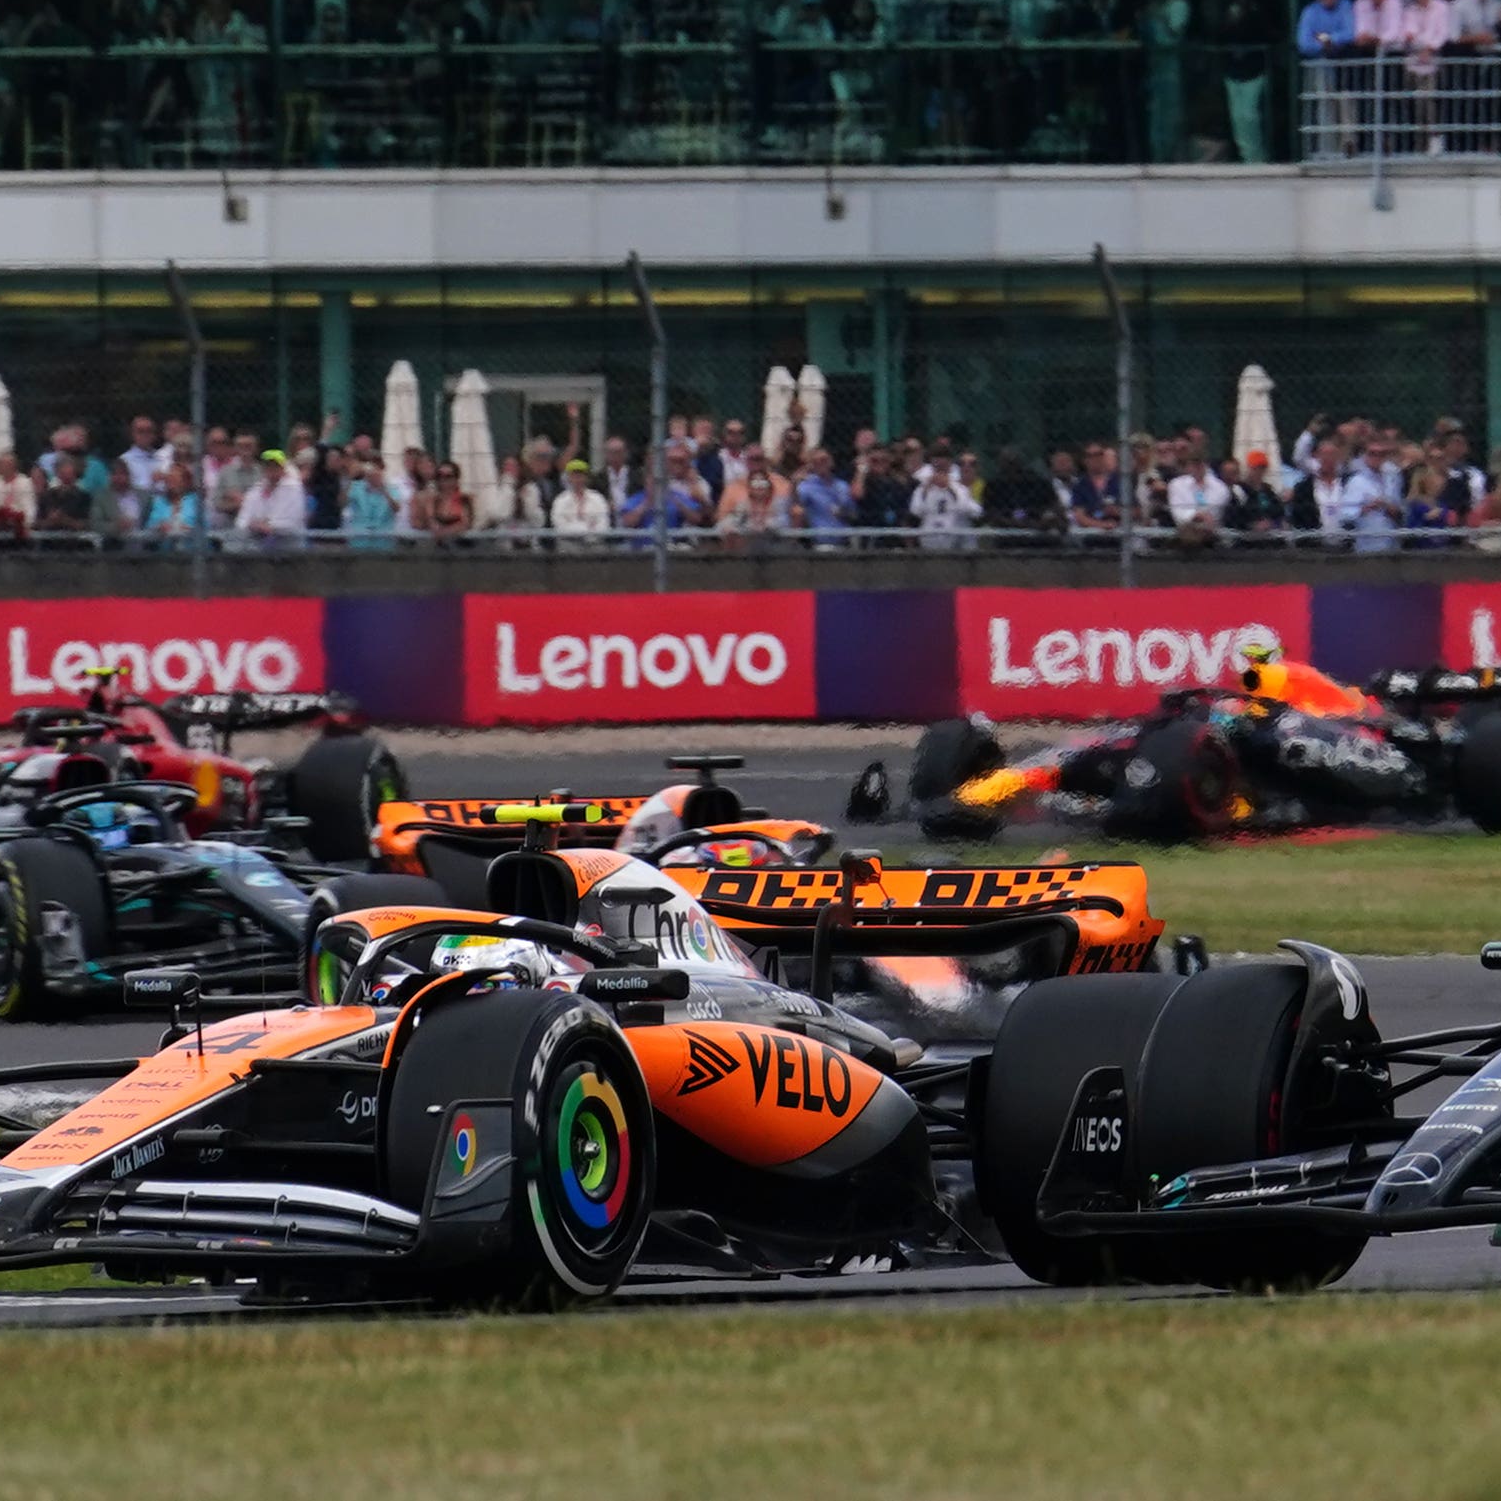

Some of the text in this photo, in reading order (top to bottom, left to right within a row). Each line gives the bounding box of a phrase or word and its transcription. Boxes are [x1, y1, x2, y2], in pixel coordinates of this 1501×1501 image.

[9, 627, 299, 695] Lenovo
[497, 623, 787, 693] Lenovo
[988, 617, 1283, 688] Lenovo
[134, 979, 172, 993] Medallia
[596, 976, 649, 991] Medallia
[686, 1002, 723, 1020] CISCO
[174, 1031, 269, 1054] 4
[735, 1030, 851, 1118] VELO
[1071, 1116, 1123, 1152] INEOS
[111, 1149, 134, 1180] JACK
